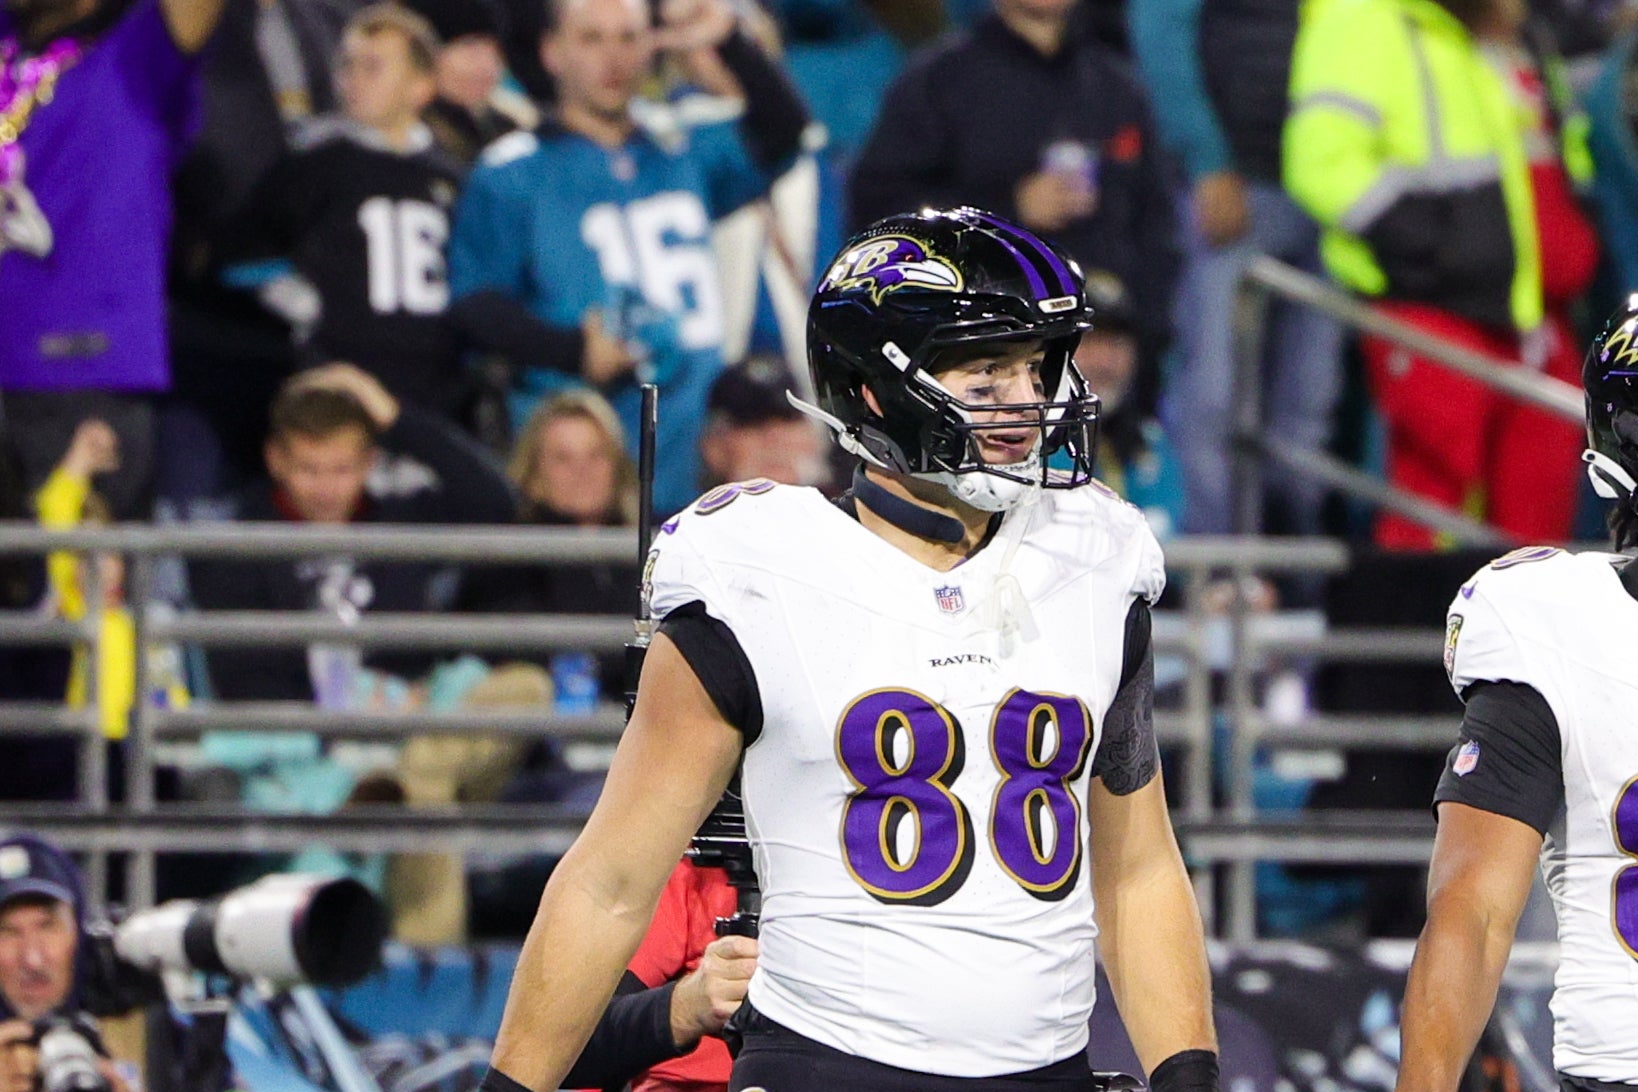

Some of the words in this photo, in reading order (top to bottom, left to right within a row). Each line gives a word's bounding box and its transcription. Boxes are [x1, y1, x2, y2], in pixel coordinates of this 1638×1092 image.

[579, 190, 724, 349] 16
[928, 653, 996, 670] RAVEN
[834, 687, 1094, 907] 88
